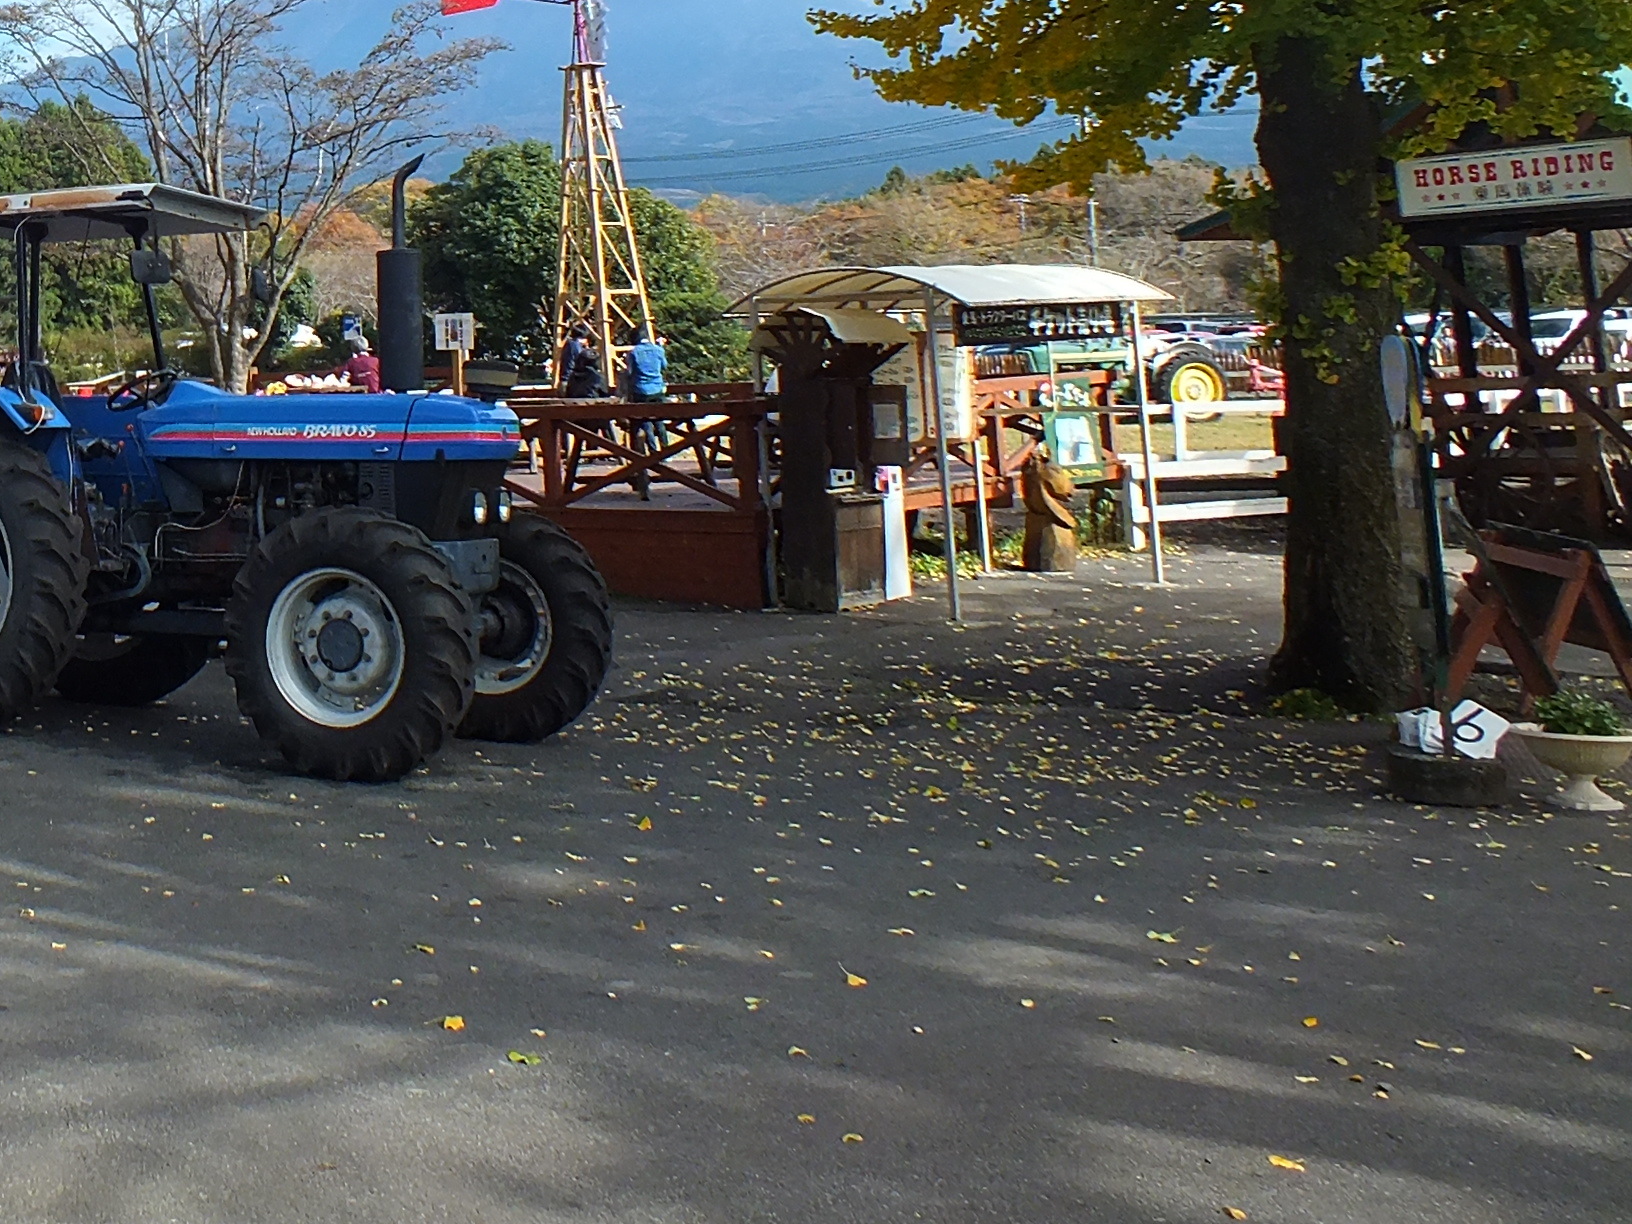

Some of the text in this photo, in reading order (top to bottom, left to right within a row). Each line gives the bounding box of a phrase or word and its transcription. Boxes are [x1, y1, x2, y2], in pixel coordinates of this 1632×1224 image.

[1414, 151, 1614, 187] HORSE RIDING
[303, 424, 356, 438] BRAVO
[358, 424, 377, 438] 85
